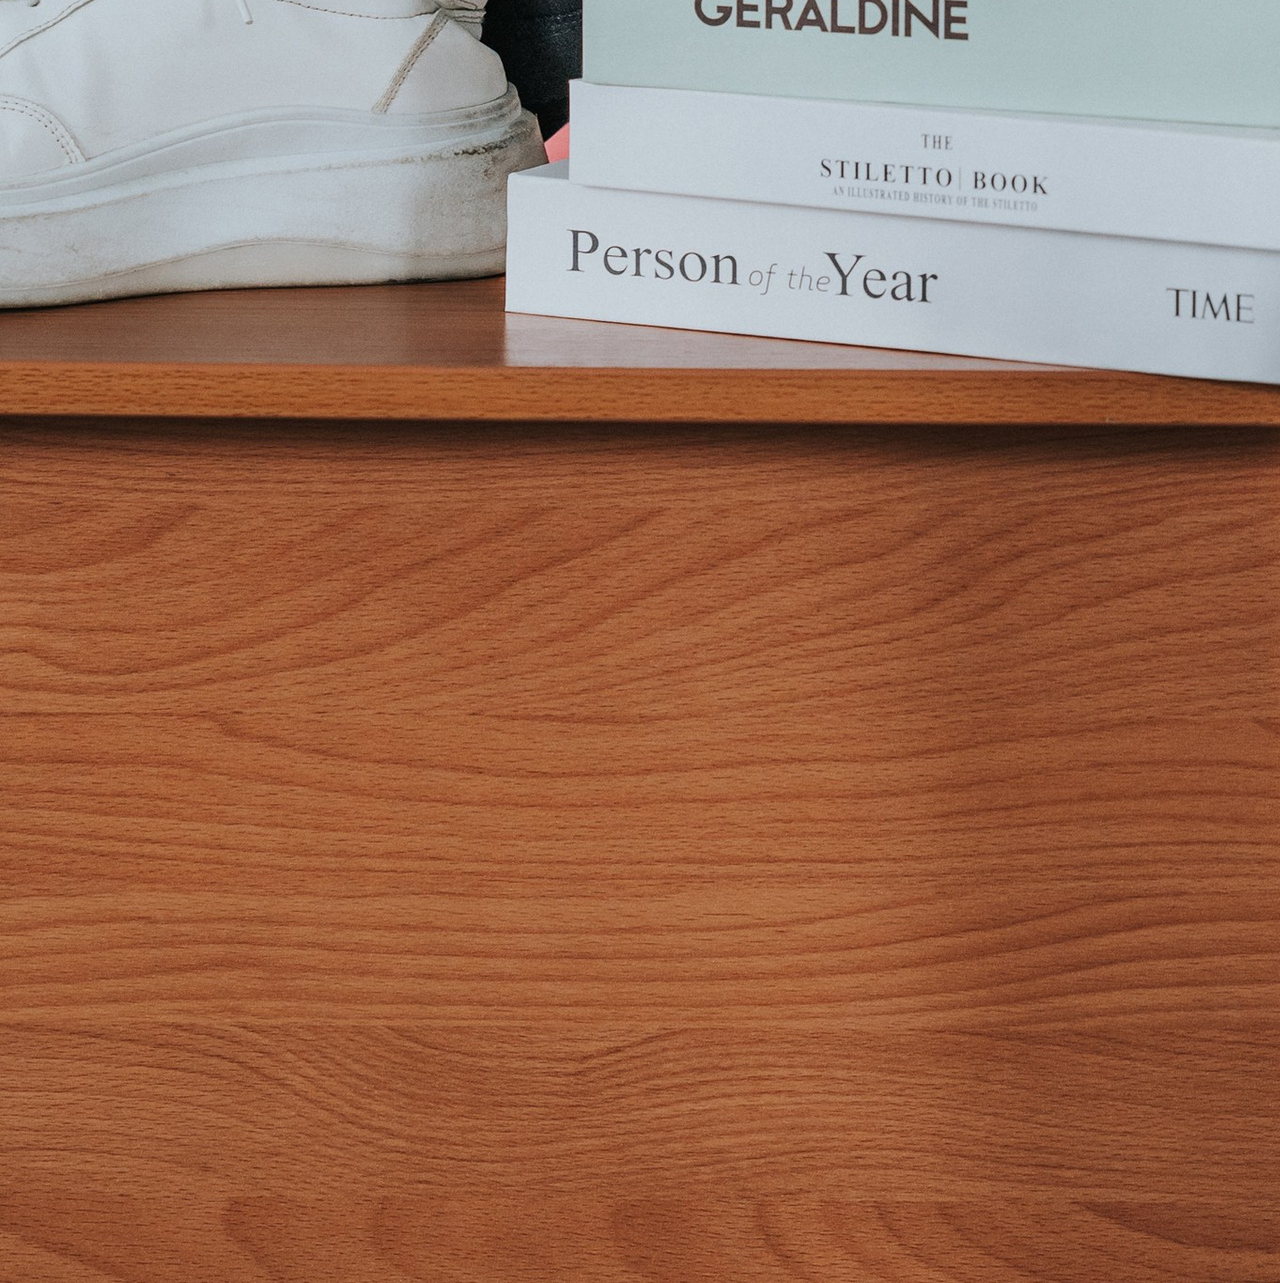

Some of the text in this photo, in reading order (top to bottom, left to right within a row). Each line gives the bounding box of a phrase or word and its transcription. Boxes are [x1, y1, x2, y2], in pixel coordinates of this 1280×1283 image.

[921, 134, 953, 150] THE
[820, 158, 1048, 195] STILETTO BOOK
[847, 187, 910, 201] ILLUSTRATED
[913, 192, 952, 205] HISTORY
[566, 229, 938, 304] Person of the Year
[1166, 288, 1254, 324] TIME
